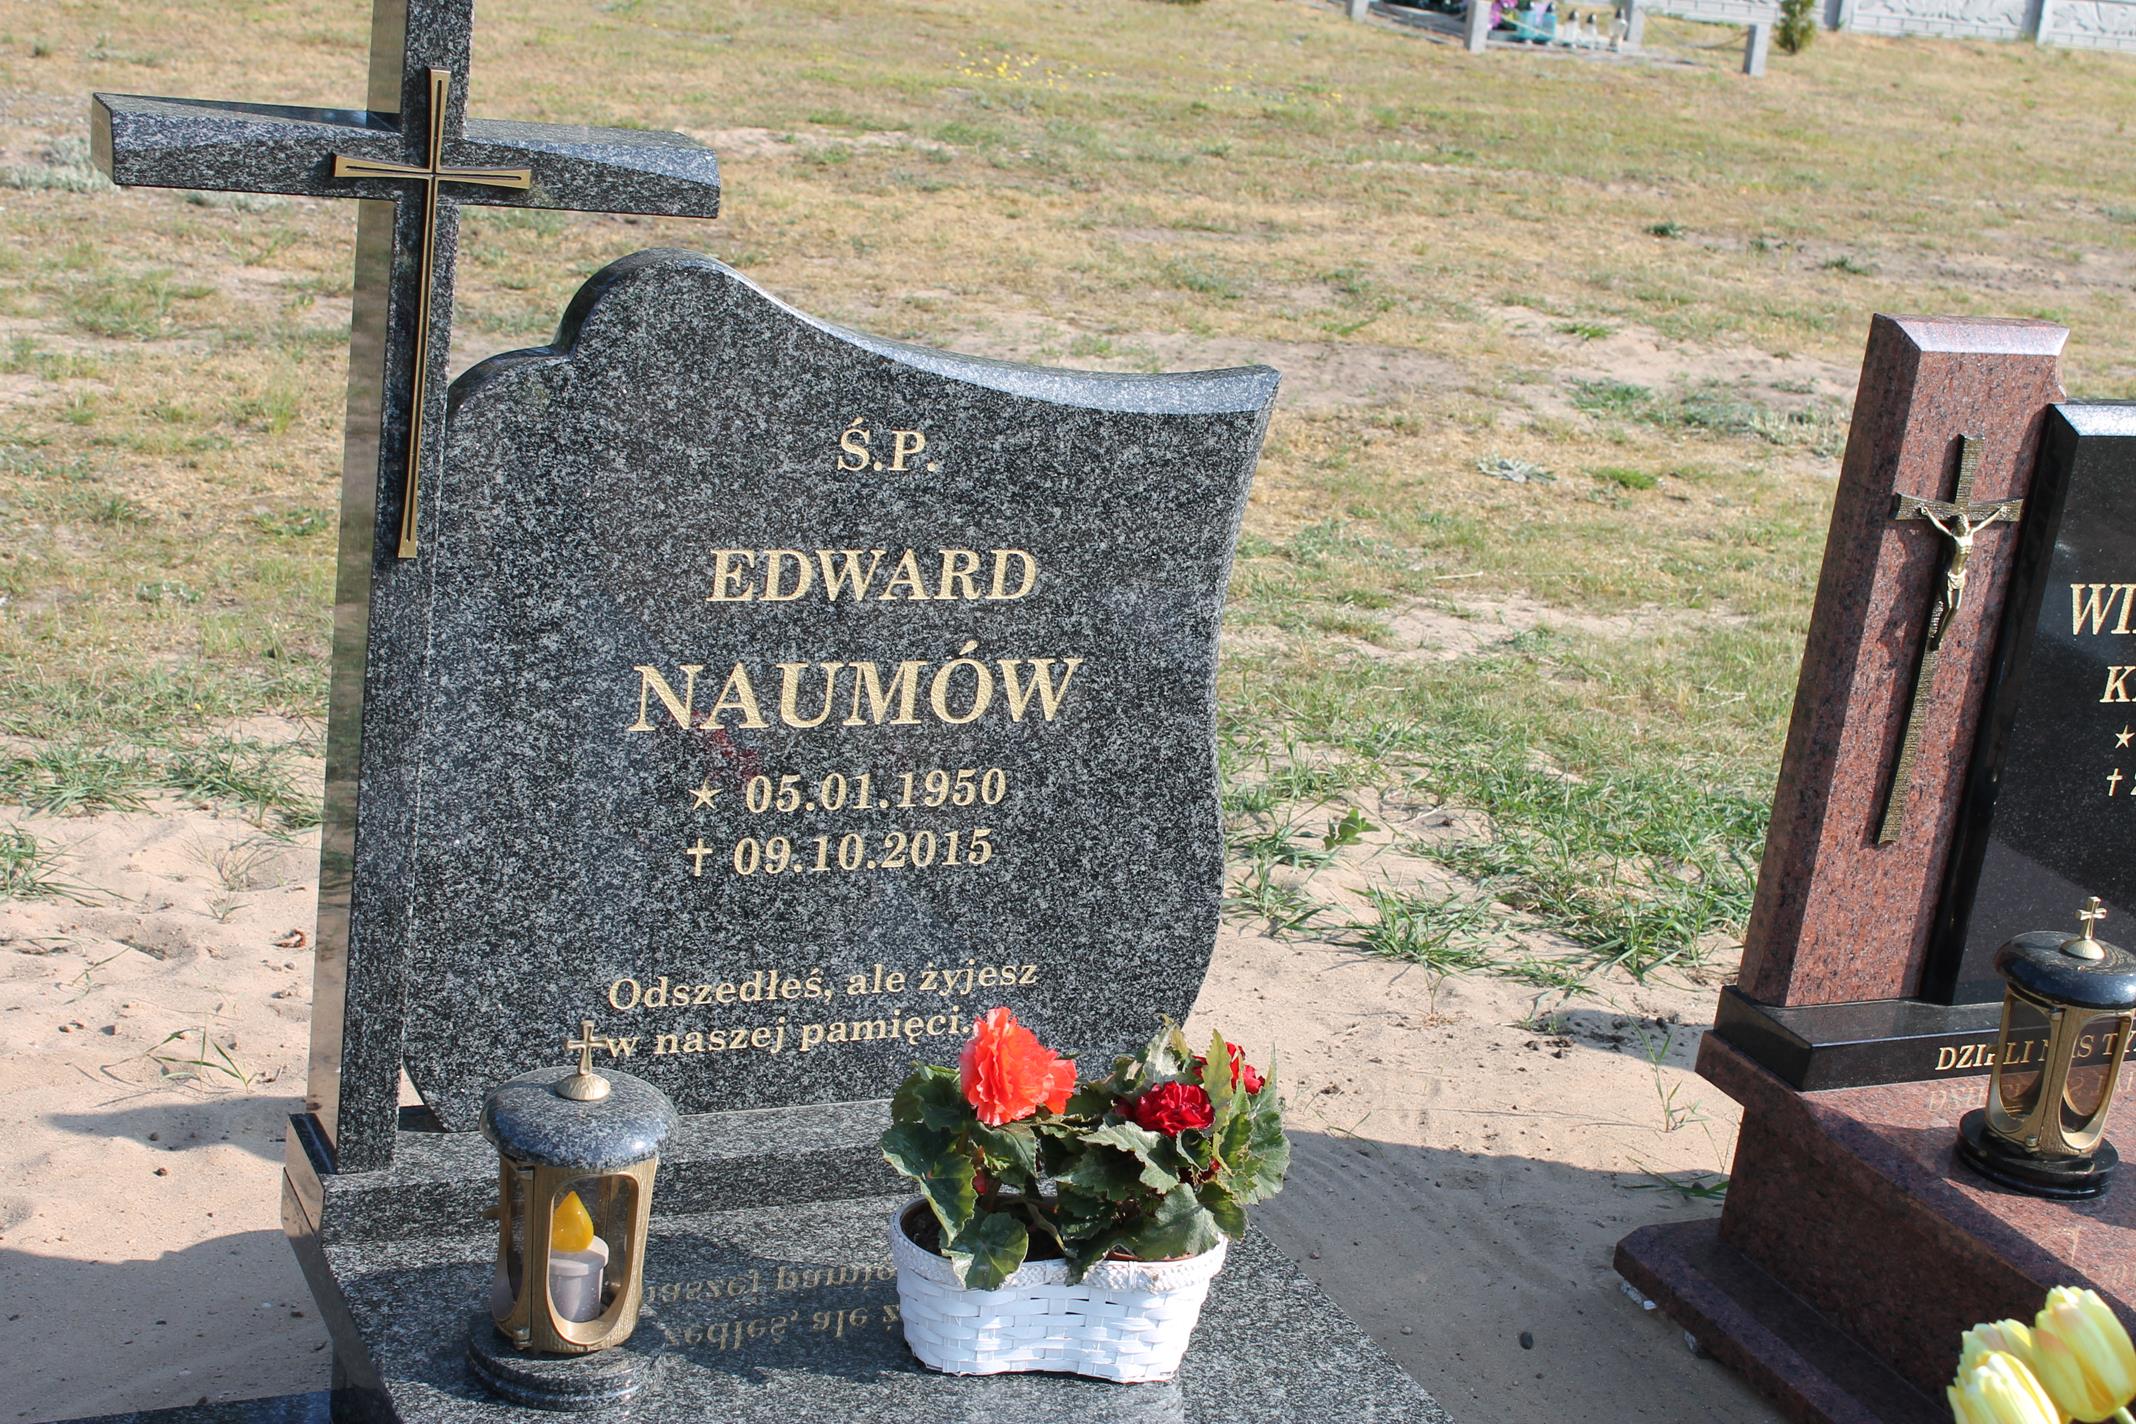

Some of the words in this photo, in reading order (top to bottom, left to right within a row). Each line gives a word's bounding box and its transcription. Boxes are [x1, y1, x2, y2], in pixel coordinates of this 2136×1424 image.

[837, 416, 938, 472] Ś.P.
[706, 548, 1039, 602] EDWARD
[2070, 583, 2136, 636] WI
[628, 640, 1085, 732] NAUMÓW
[2099, 665, 2136, 703] K
[745, 767, 1007, 815] 05.01.1950
[734, 828, 994, 875] 09.10.2015
[608, 966, 834, 1011] Odszedłeś,
[847, 962, 906, 997] ale
[919, 958, 1038, 998] żyjesz
[605, 1034, 640, 1059] w
[655, 1015, 786, 1056] naszej
[800, 1005, 973, 1052] pamięci.
